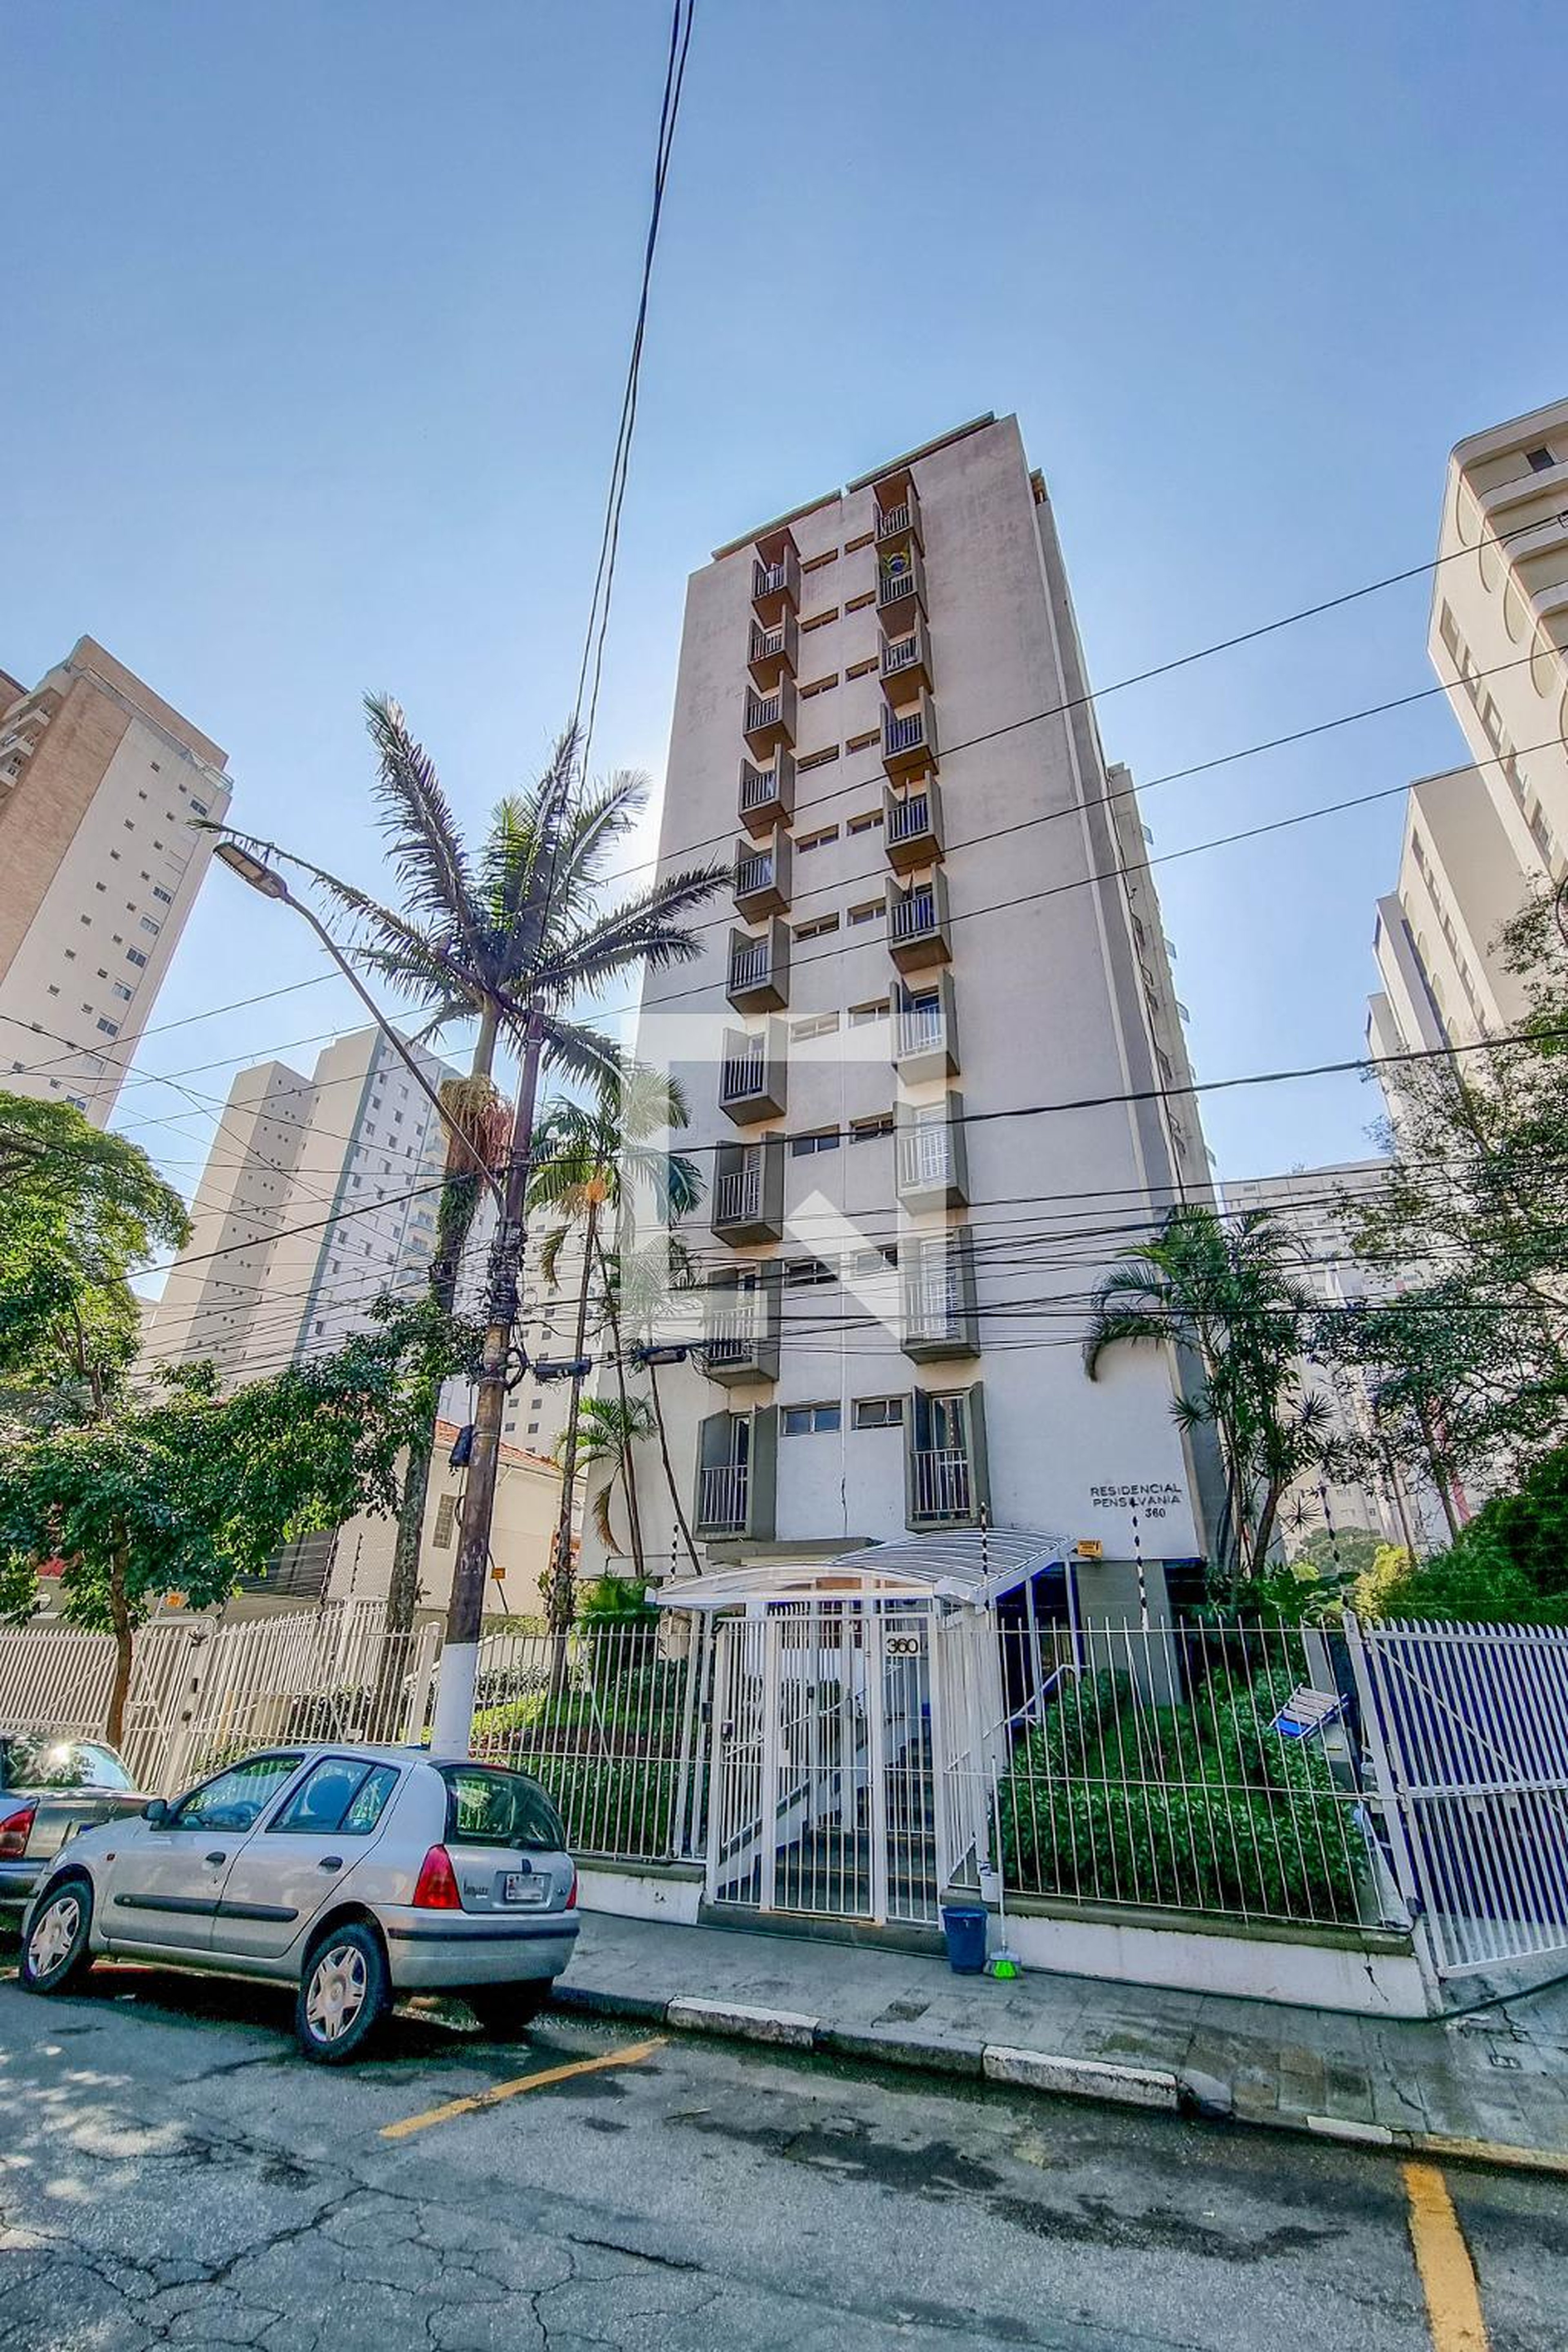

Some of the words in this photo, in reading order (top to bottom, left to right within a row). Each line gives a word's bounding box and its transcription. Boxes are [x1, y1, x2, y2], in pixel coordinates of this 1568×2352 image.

[1090, 1483, 1182, 1497] RESIDENCIAL
[1145, 1508, 1166, 1518] 360
[886, 1638, 918, 1654] 360
